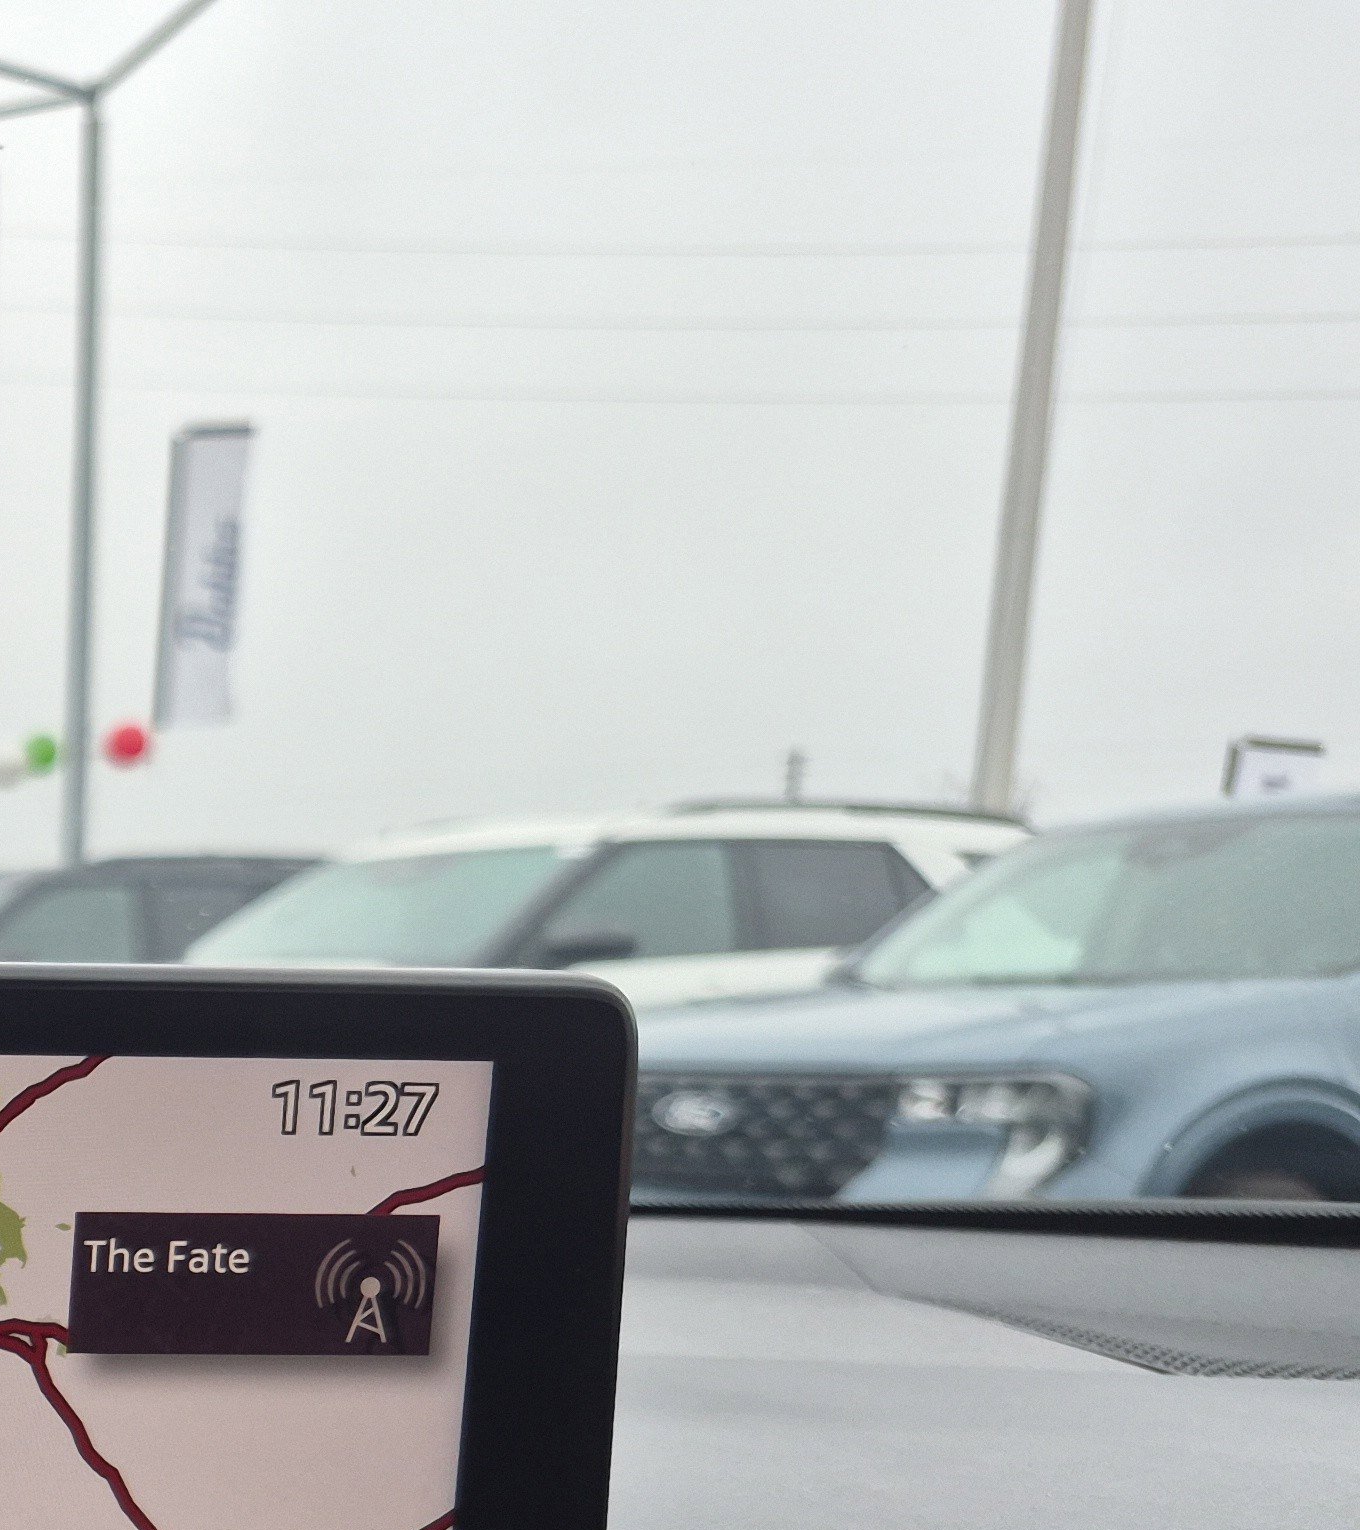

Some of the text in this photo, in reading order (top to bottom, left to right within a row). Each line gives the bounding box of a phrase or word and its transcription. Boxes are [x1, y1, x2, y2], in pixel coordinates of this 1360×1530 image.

[271, 1079, 440, 1137] 11:27
[83, 1239, 250, 1275] The Fate
